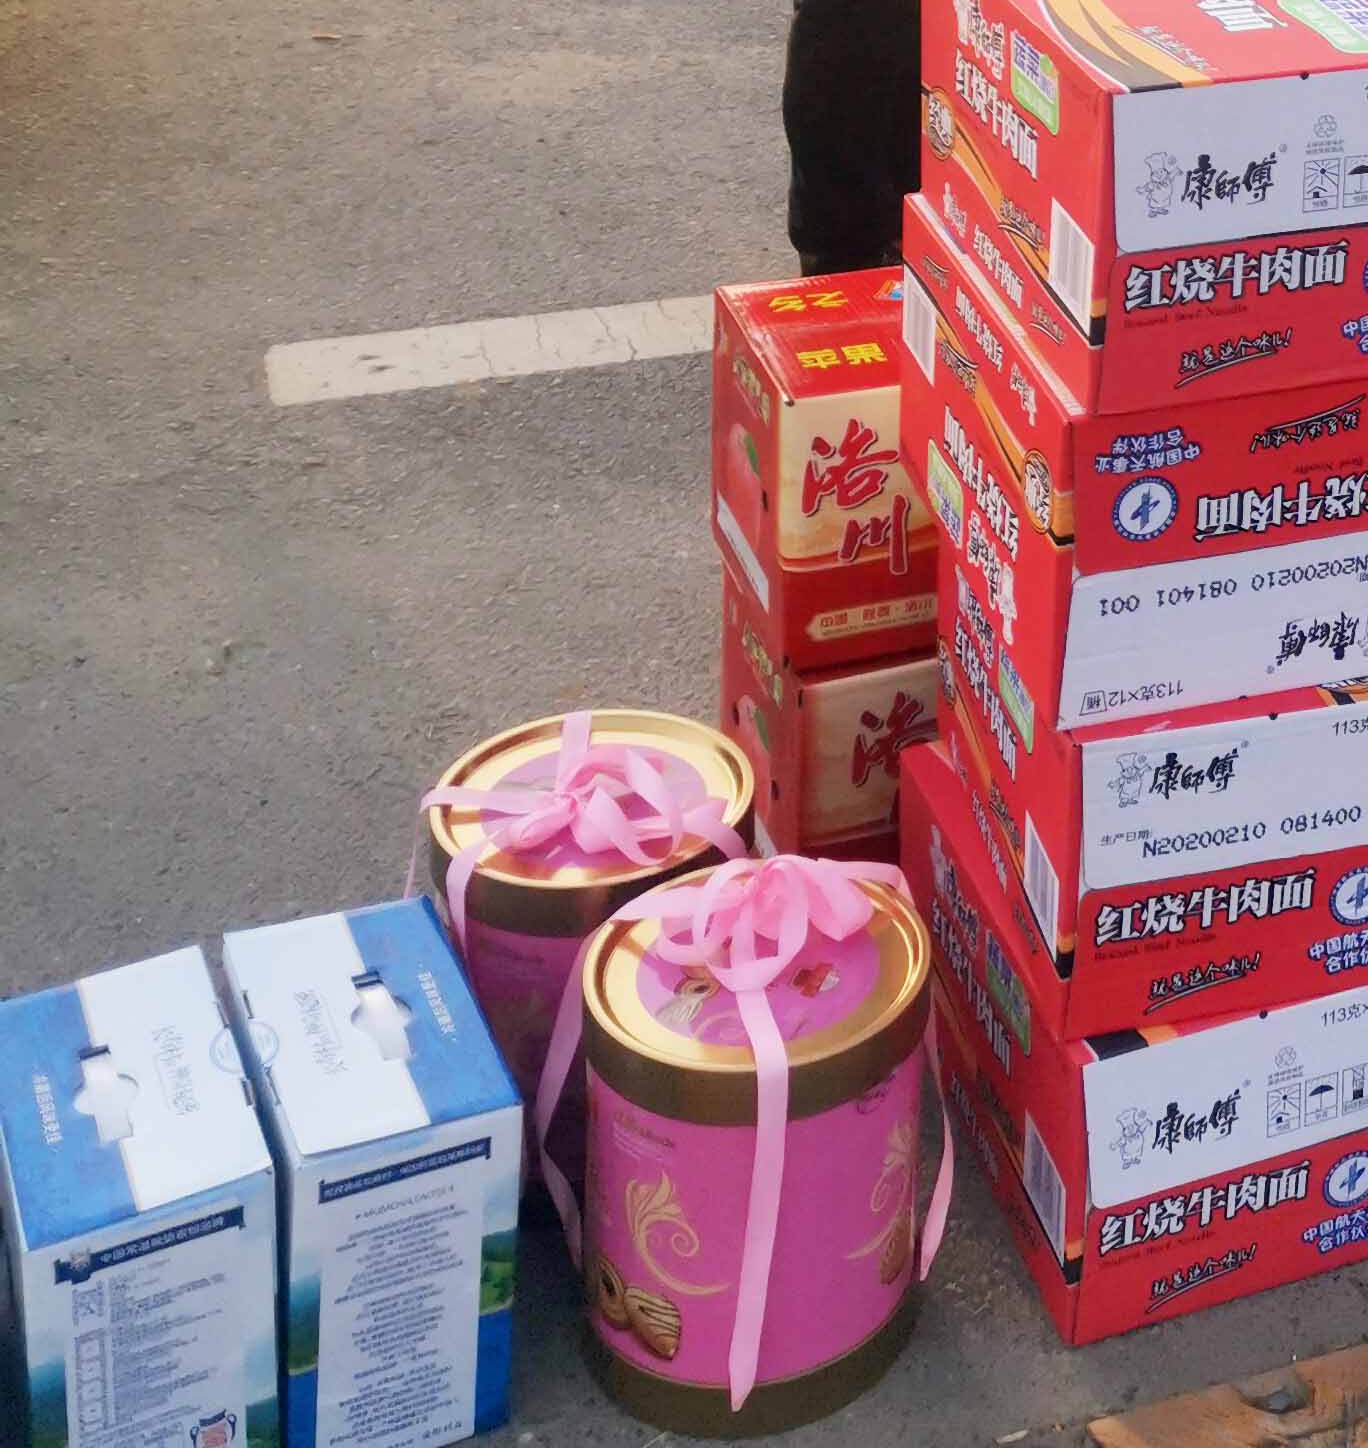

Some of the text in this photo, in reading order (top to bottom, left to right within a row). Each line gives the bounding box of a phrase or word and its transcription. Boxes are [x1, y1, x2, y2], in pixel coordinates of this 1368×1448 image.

[955, 49, 1038, 180] 红烧牛肉面
[1182, 153, 1278, 211] 康師傅
[1123, 239, 1350, 313] 红烧牛肉面
[1095, 441, 1204, 477] 中国航天事业
[1112, 426, 1188, 457] 合作伙伴
[1100, 554, 1368, 619] N20200210 081401 001
[1148, 748, 1240, 800] 康師傅
[1141, 820, 1266, 860] N20200210
[1280, 804, 1362, 836] 081400
[1093, 867, 1317, 949] 红烧牛肉面
[1152, 1088, 1243, 1155] 康師傅
[1099, 1159, 1312, 1259] 红烧牛肉面
